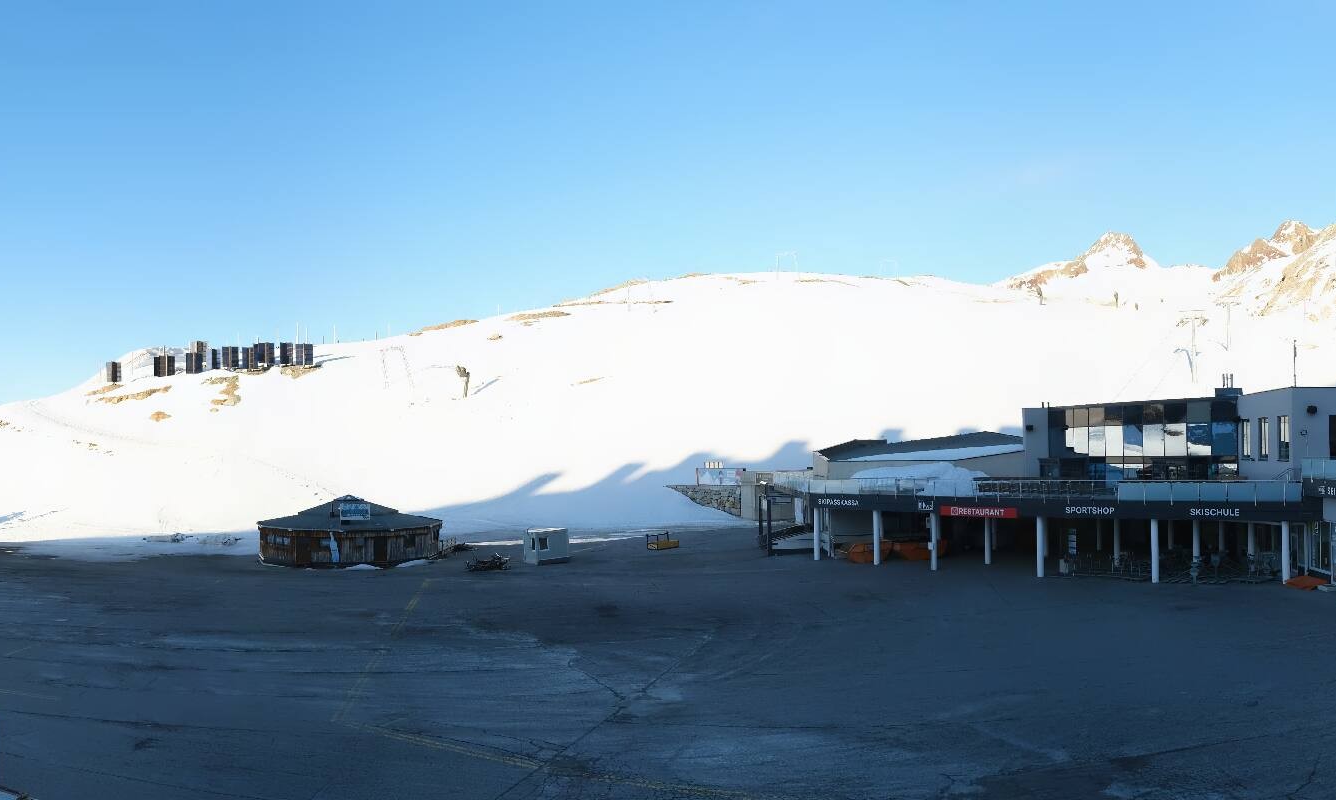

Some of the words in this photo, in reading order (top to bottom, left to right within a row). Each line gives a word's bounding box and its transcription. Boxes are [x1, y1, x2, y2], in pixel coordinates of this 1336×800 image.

[958, 507, 1004, 516] RESTAURANT
[1065, 506, 1115, 515] SPORTSHOP
[1189, 508, 1240, 517] SKISCHULE
